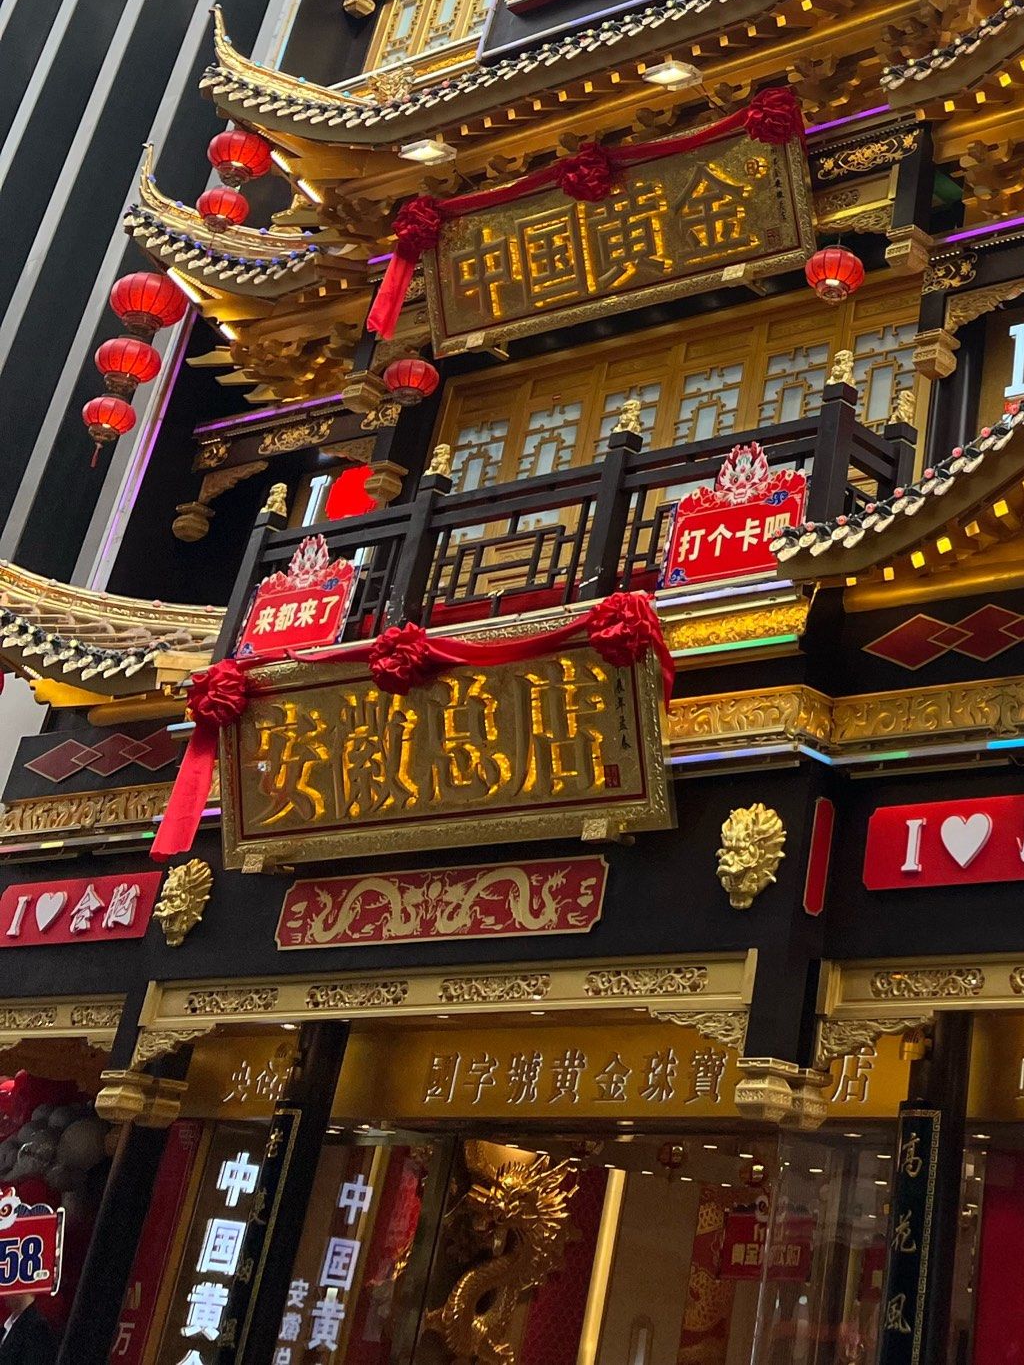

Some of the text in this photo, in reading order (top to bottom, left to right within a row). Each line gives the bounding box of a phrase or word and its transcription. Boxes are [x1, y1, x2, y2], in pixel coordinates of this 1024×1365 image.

[451, 162, 762, 316] 中国黄金
[677, 512, 792, 563] 打个卡吧
[253, 595, 341, 634] 来都来了
[250, 656, 607, 827] 安徽总店
[900, 817, 927, 873] I
[5, 883, 141, 936] I 合肥
